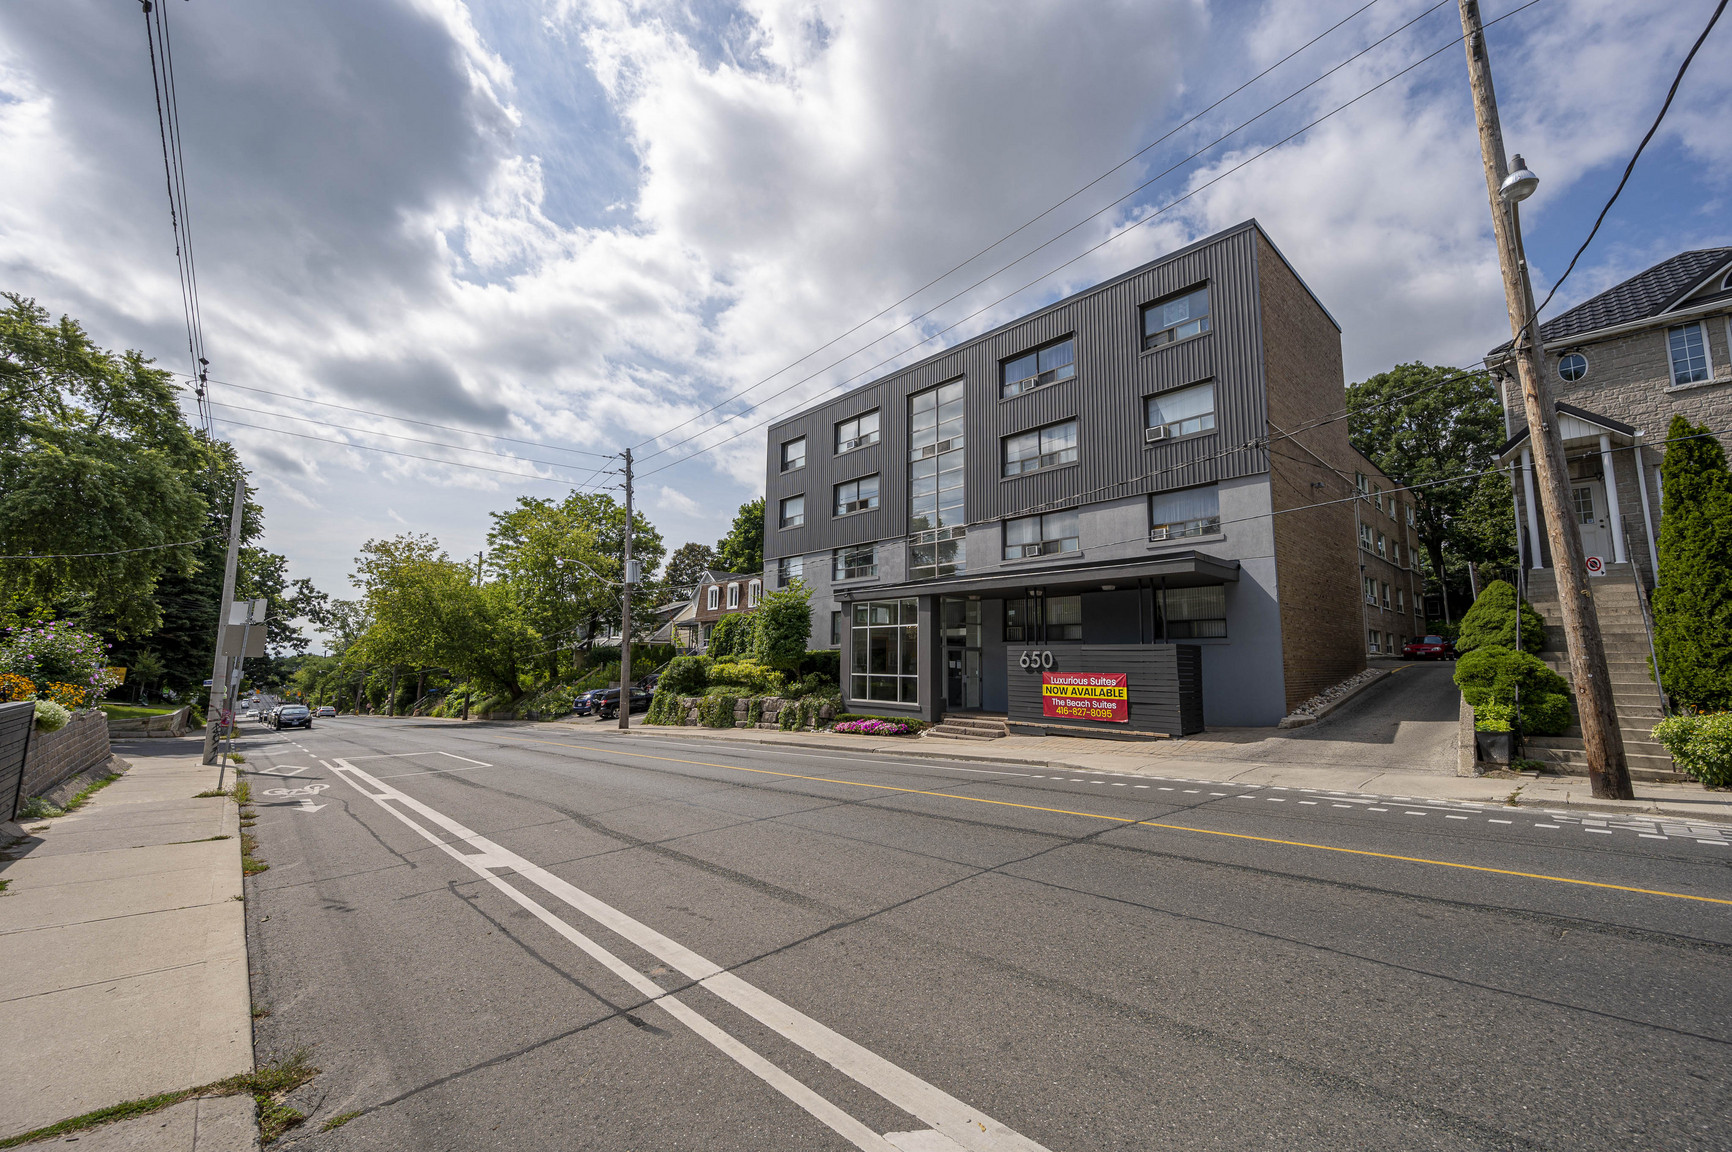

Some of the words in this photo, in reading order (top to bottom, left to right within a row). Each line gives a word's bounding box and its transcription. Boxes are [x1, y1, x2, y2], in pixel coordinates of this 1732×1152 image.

[1020, 650, 1053, 668] 650
[1050, 676, 1088, 685] Luxurious
[1090, 677, 1117, 686] Suites
[1045, 686, 1069, 695] NOW
[1071, 687, 1124, 698] AVAILABLE
[1051, 698, 1065, 706] The
[1066, 699, 1091, 708] Beach
[1092, 700, 1117, 709] Suites
[1056, 706, 1113, 718] 416-827-8095
